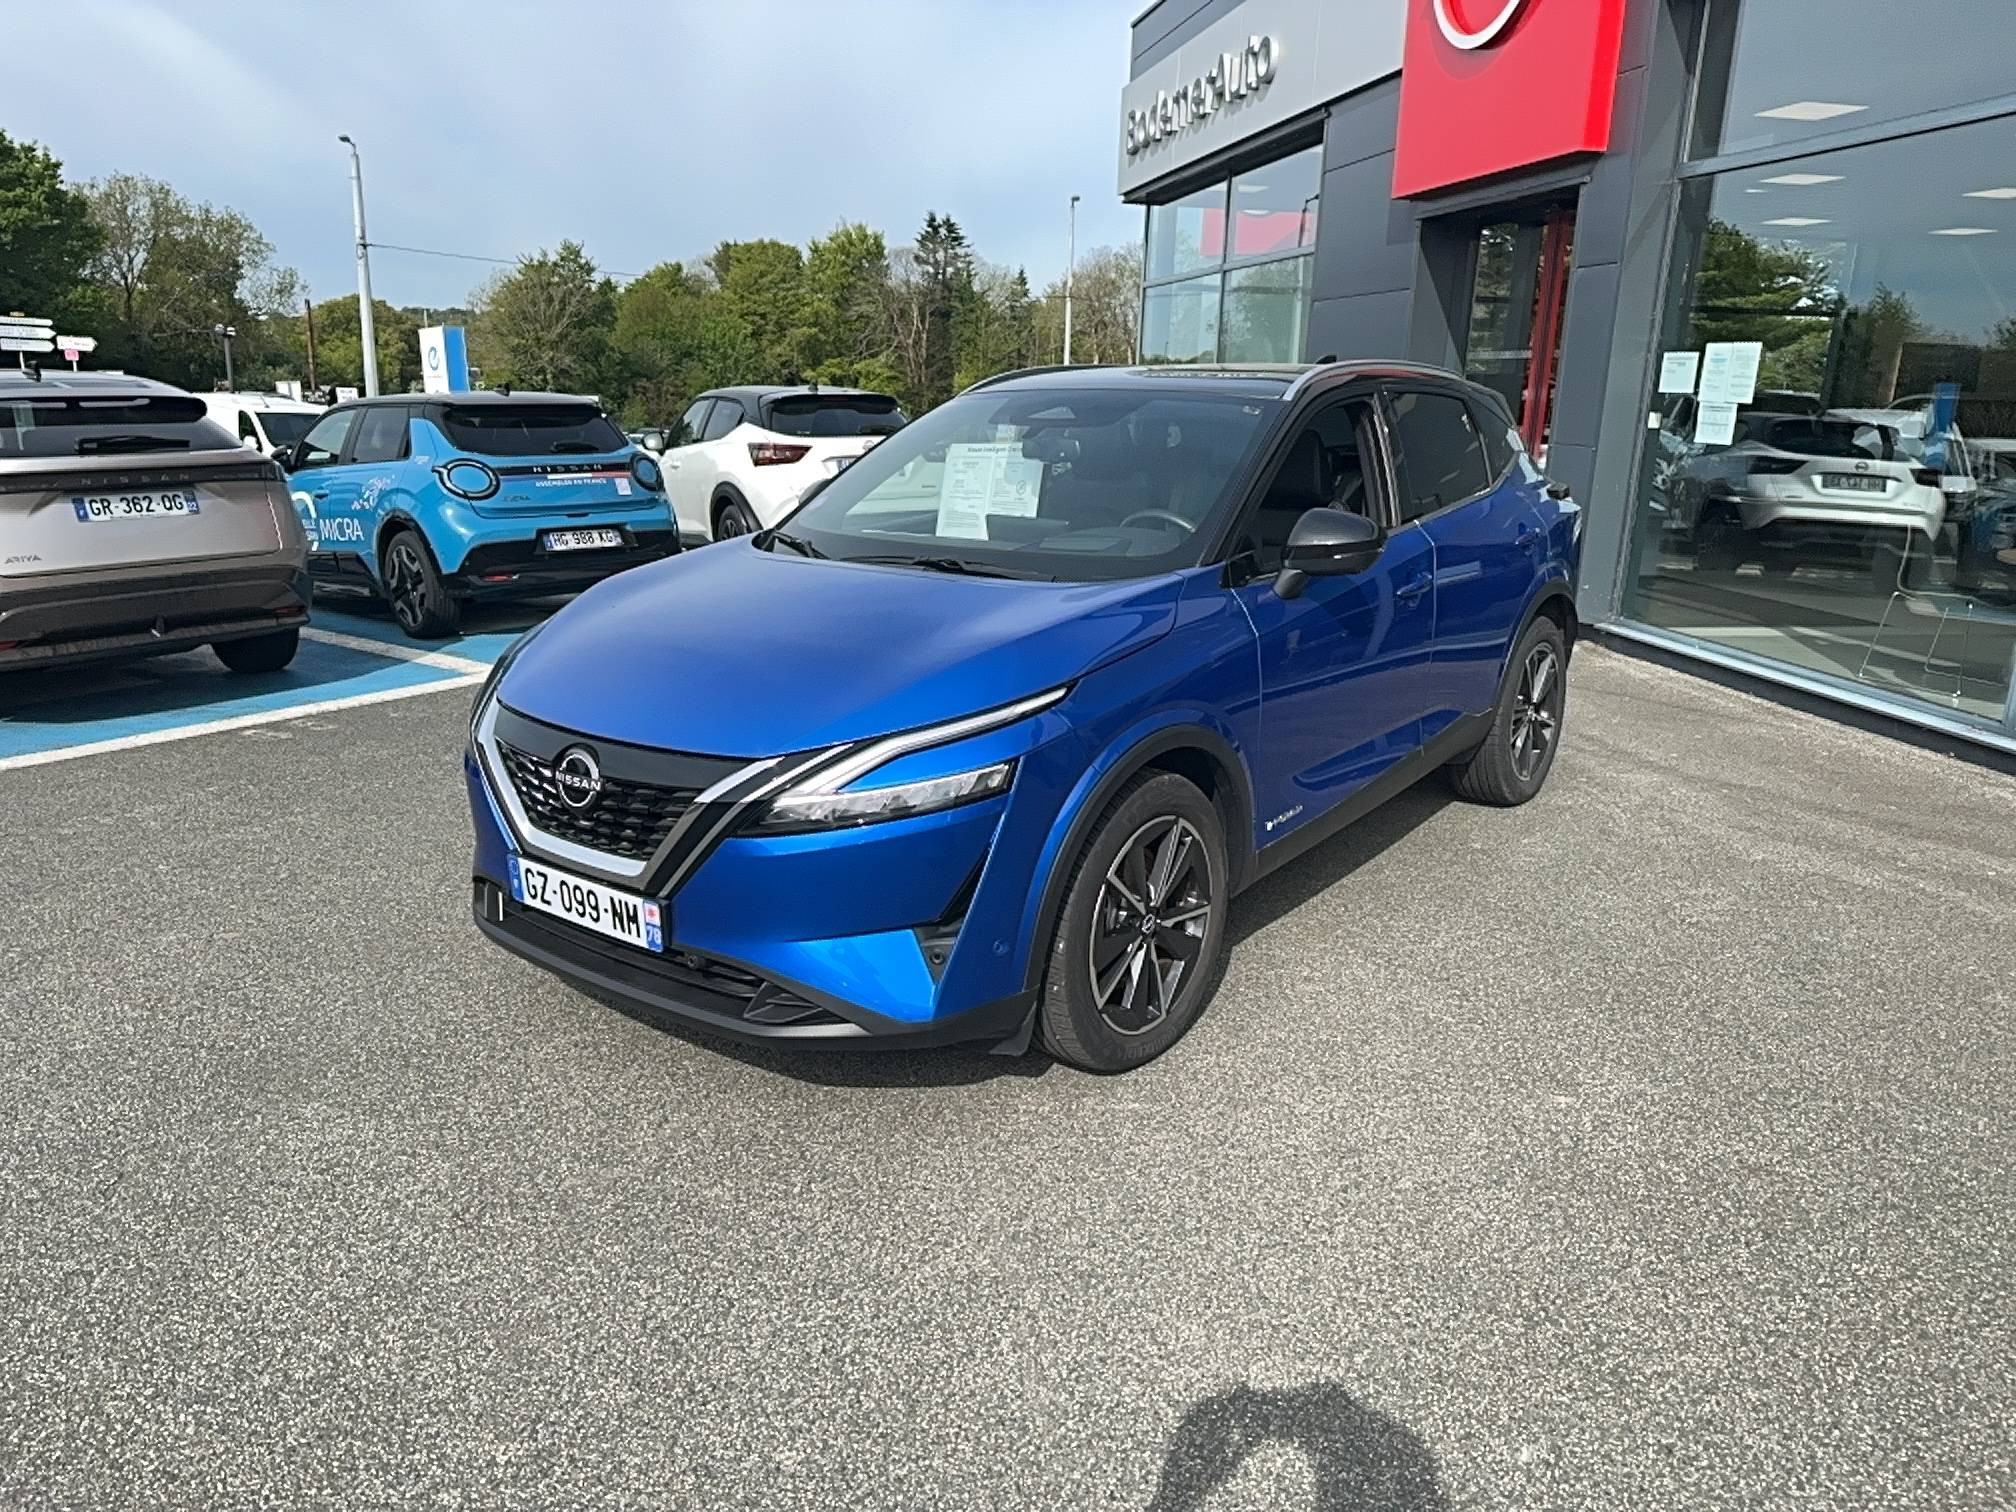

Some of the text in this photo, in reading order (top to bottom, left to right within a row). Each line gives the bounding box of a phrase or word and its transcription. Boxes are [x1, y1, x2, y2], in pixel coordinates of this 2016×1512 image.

[81, 474, 189, 486] NISSAN
[319, 517, 364, 541] MICRA
[556, 770, 601, 792] NISSAN
[525, 867, 642, 939] GZ-099-NM
[646, 925, 662, 943] 78
